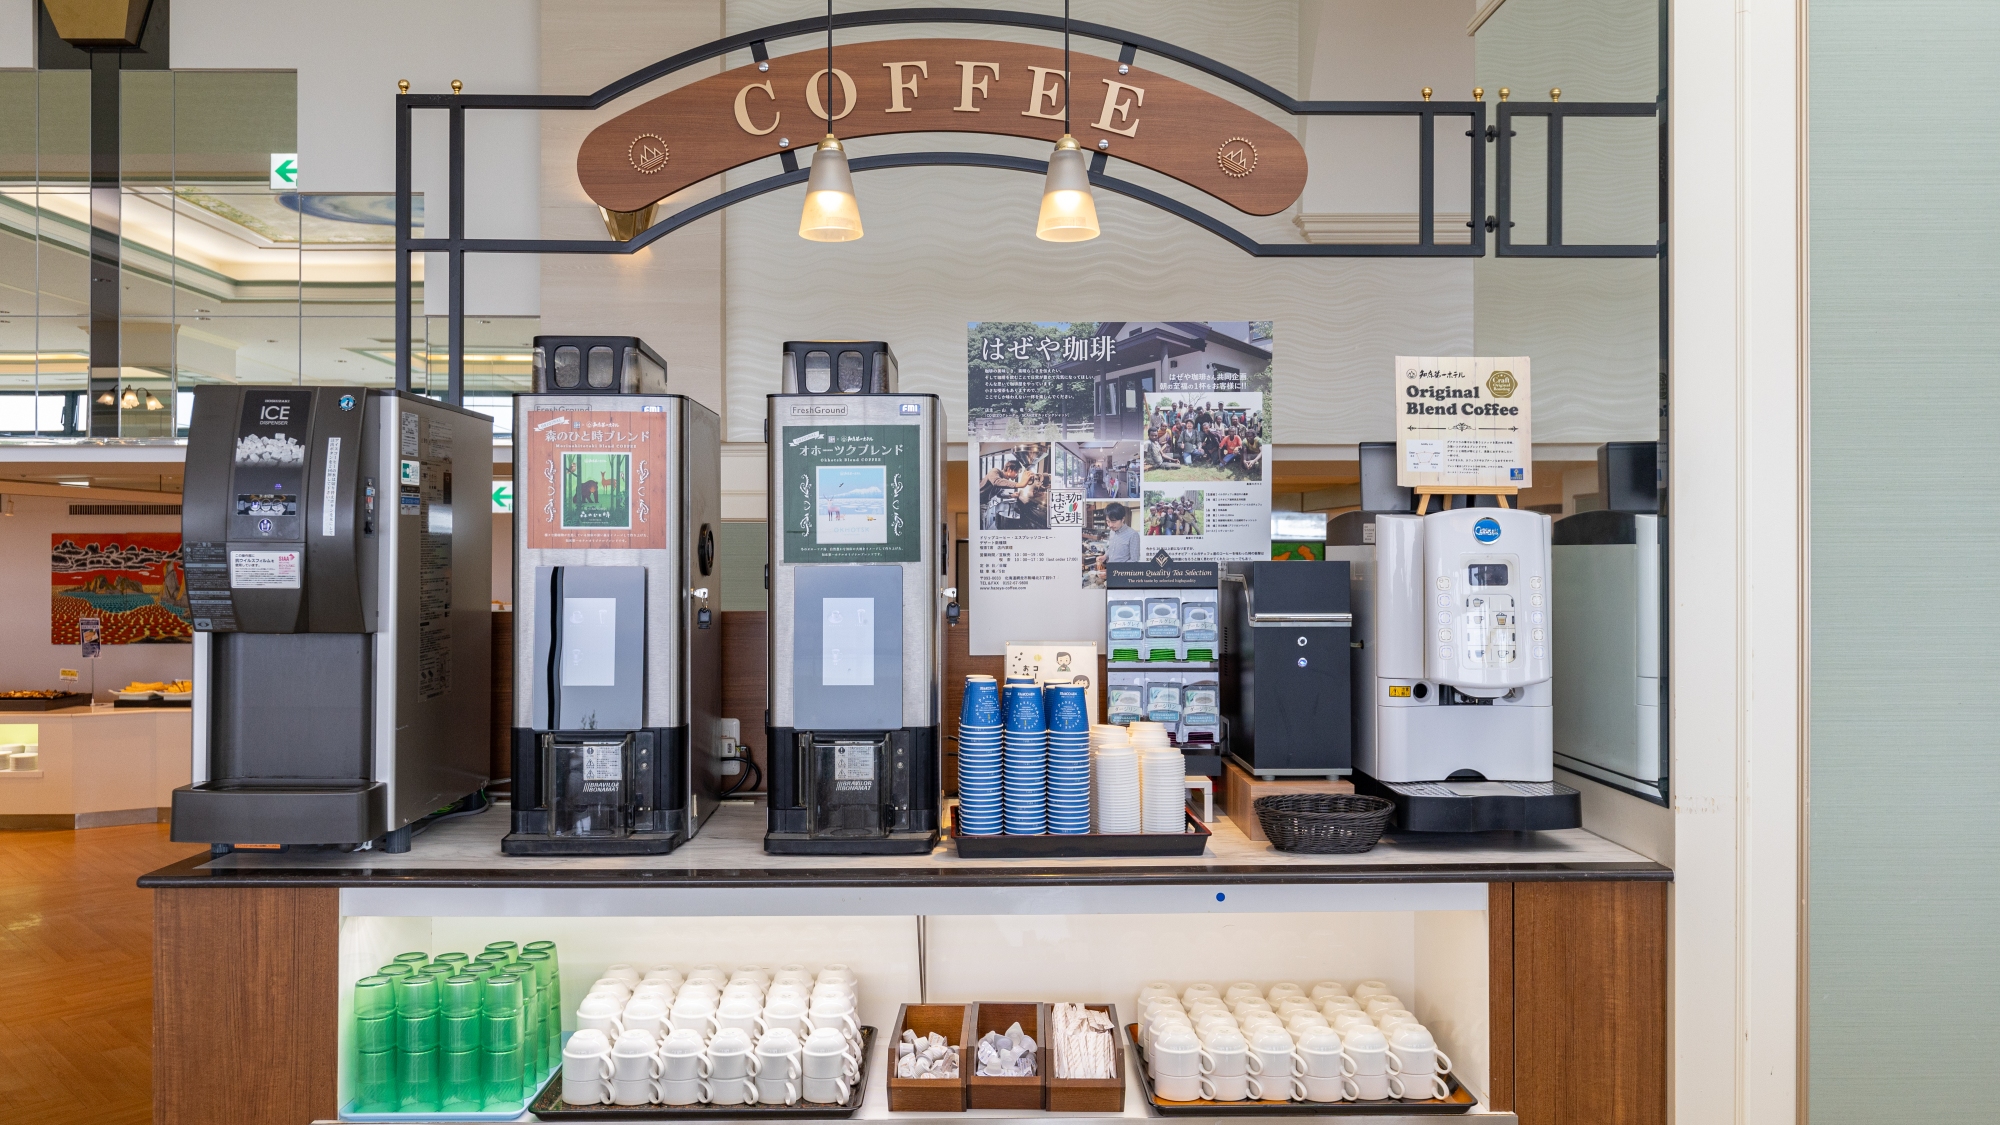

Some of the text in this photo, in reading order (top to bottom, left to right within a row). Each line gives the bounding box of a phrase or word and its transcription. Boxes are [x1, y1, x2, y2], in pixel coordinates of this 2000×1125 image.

[733, 59, 1145, 138] COFFEE
[982, 335, 1117, 362] はぜや珈琲
[1406, 385, 1480, 401] Original
[260, 406, 290, 420] ICE
[1406, 402, 1519, 416] Blend Coffee
[545, 431, 650, 442] 森のひと時ブレンド
[799, 444, 903, 456] オホーツクブレンド
[1051, 492, 1066, 524] はぜや
[1066, 492, 1082, 524] 珈琲
[1146, 569, 1170, 578] Quality
